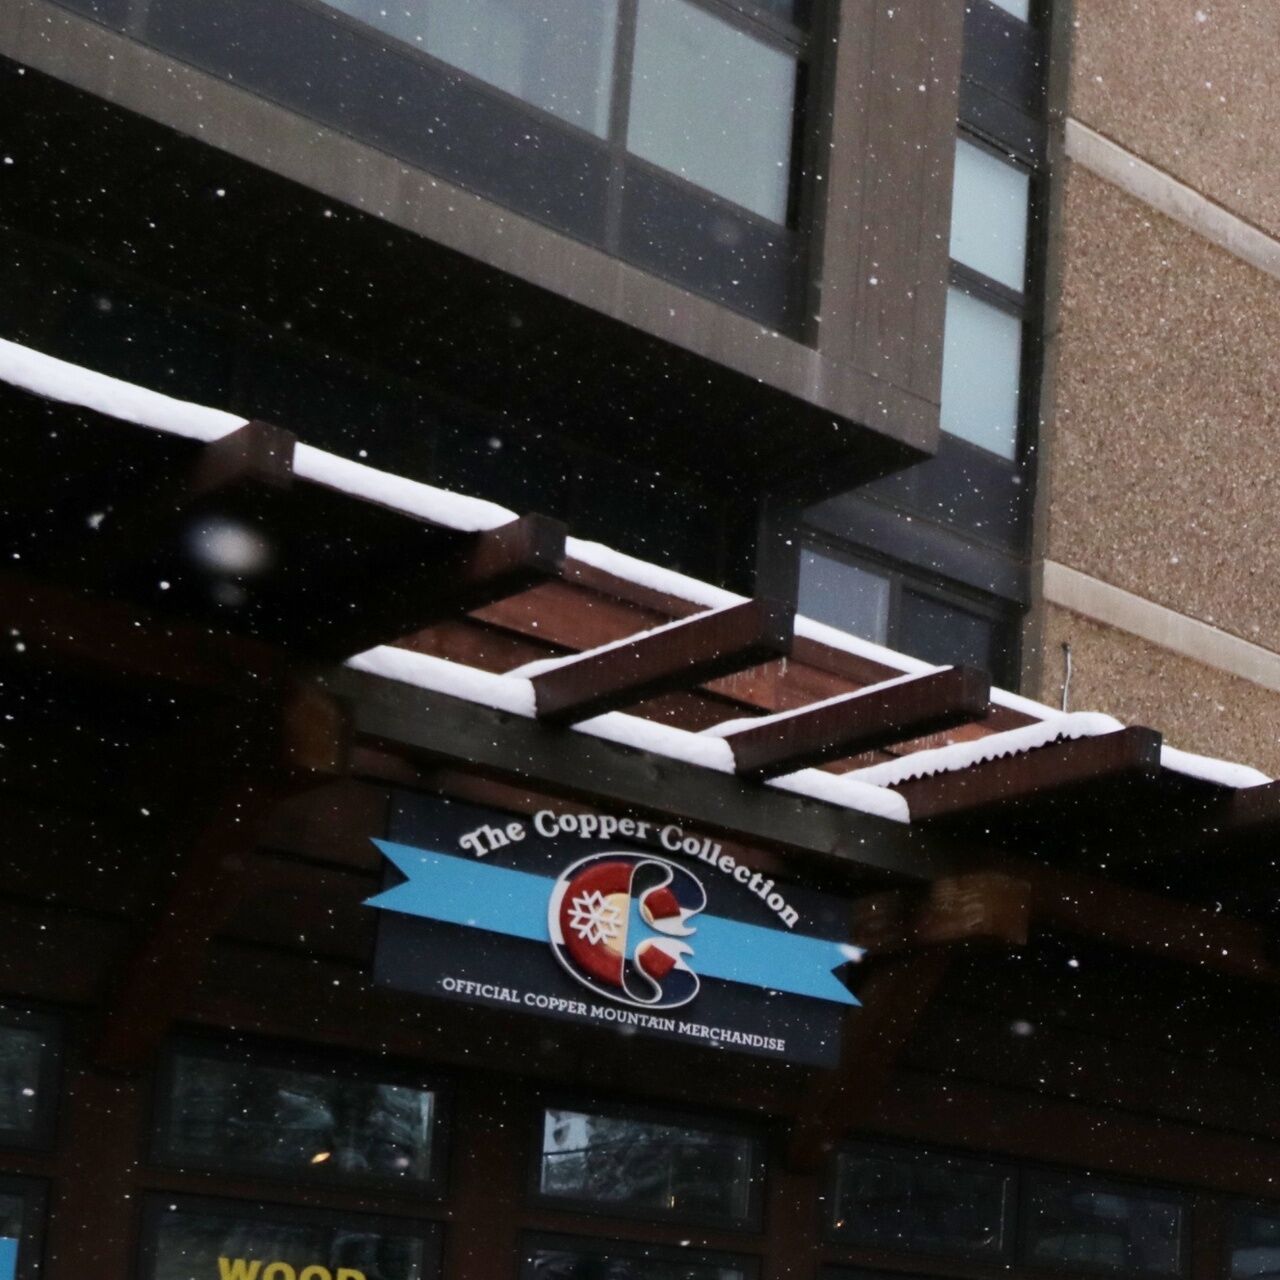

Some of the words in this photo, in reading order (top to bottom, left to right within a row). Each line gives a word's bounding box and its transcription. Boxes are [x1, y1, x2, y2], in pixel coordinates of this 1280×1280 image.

[459, 822, 526, 858] The
[534, 809, 651, 840] Copper
[660, 824, 800, 929] Collection
[442, 977, 521, 1004] OFFICIAL
[524, 992, 588, 1017] COPPER
[590, 1004, 676, 1033] MOUNTAIN
[677, 1020, 787, 1052] MERCHANDISE
